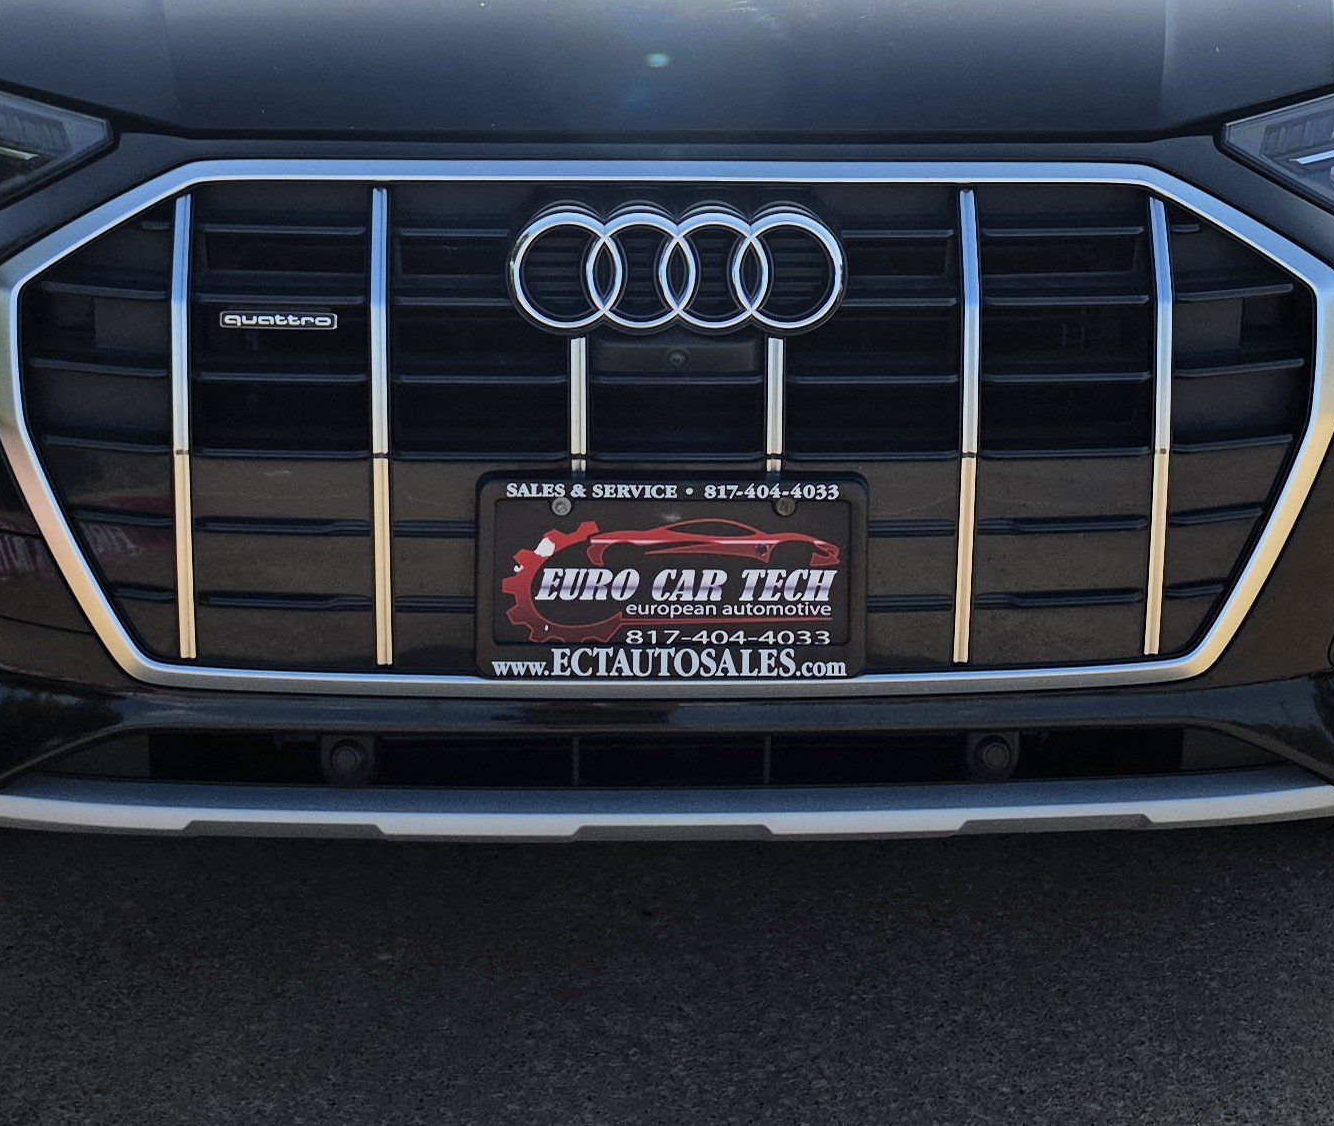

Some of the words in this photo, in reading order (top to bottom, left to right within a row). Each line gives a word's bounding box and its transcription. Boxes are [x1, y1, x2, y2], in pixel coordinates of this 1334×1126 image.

[224, 314, 332, 326] quattro
[506, 483, 566, 499] SALES
[570, 483, 588, 499] &
[592, 484, 678, 499] SERVICE
[704, 484, 840, 501] 817-404-4033
[534, 568, 641, 602] EURO
[651, 568, 729, 602] CAR
[739, 569, 838, 602] TECH
[626, 604, 717, 618] european
[722, 602, 832, 616] automotive
[625, 630, 831, 646] 817-404-4033
[492, 647, 847, 679] www.ECTAUTOSALES.com
